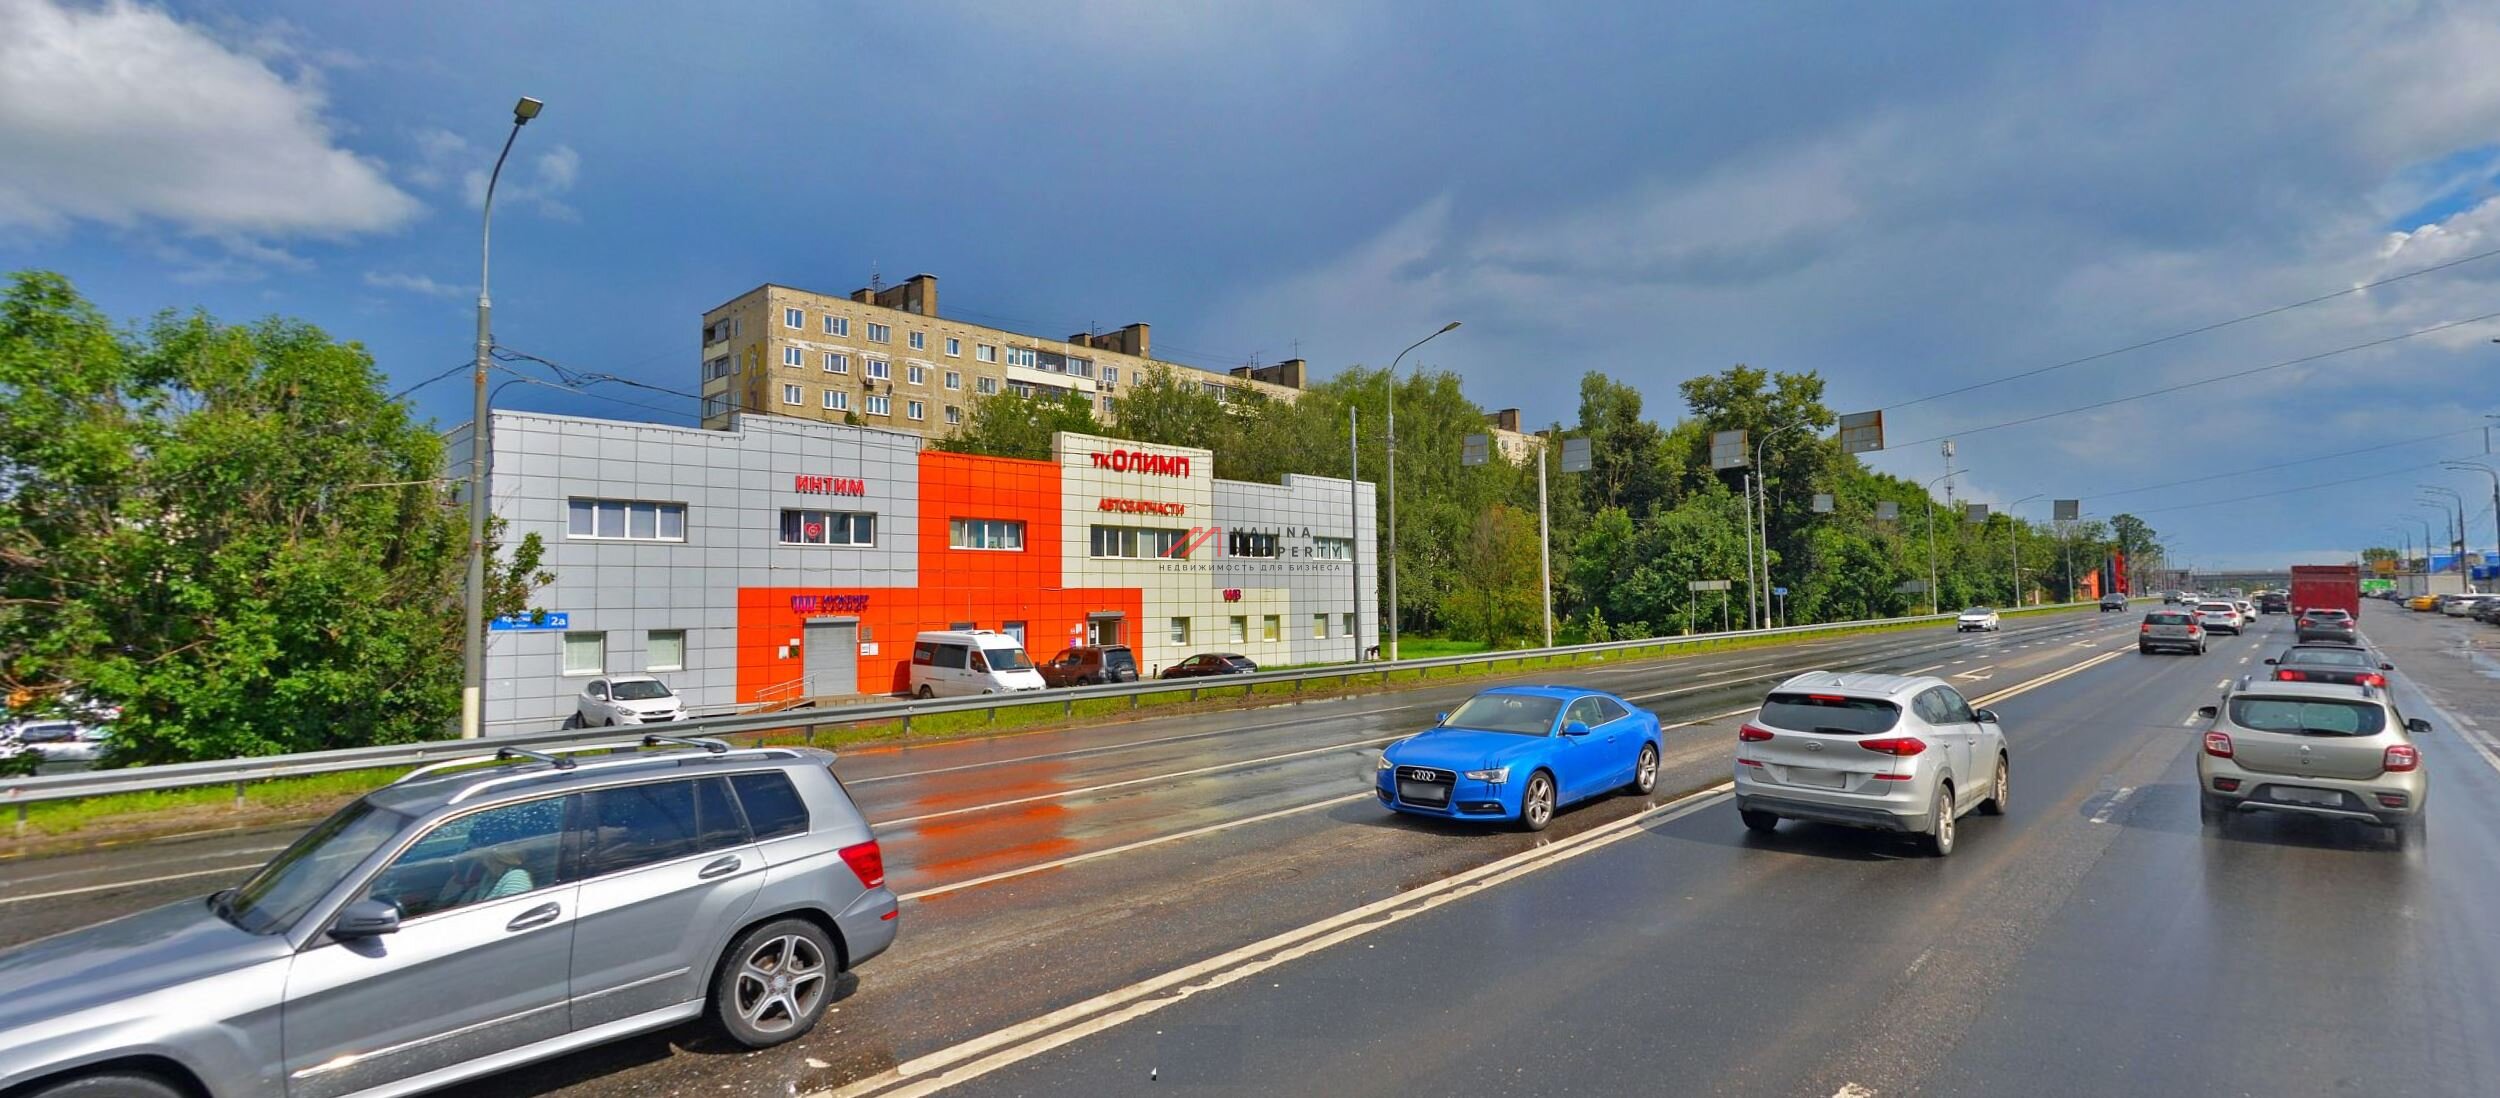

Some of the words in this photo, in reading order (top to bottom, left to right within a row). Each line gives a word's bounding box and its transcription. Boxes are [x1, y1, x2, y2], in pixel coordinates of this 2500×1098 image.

[1113, 450, 1189, 478] ОЛИМП
[795, 475, 865, 496] ИНТИМ
[1097, 498, 1185, 516] АВТОЗАПЧАСТИ
